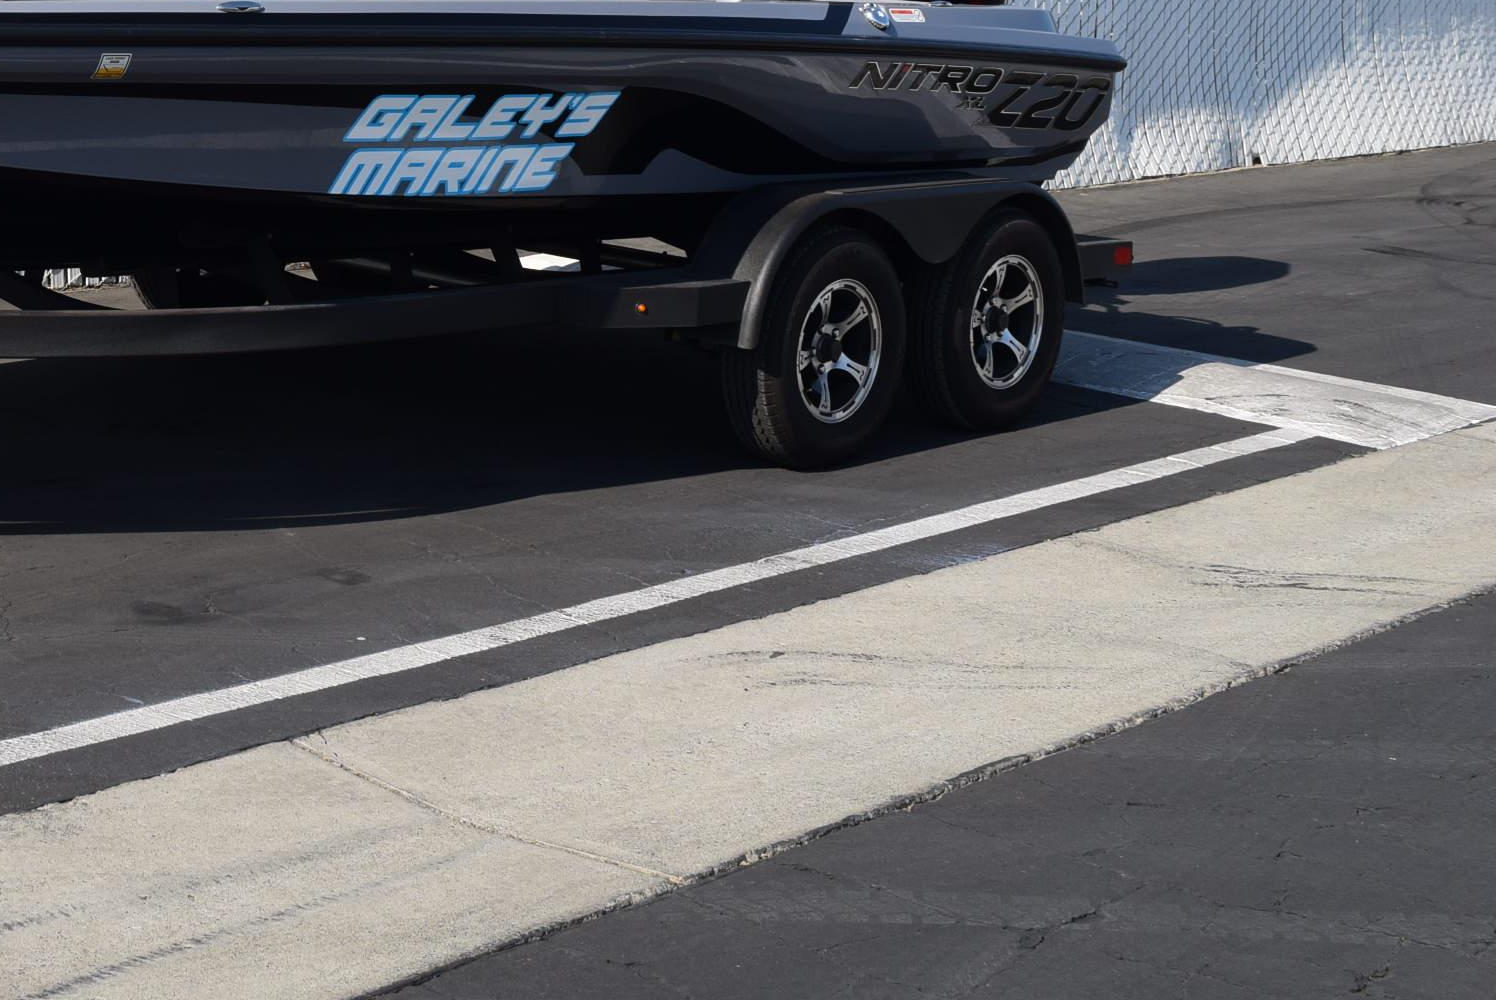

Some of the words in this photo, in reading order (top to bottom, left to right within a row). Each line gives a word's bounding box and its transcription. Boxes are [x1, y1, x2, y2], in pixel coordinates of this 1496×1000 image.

[849, 61, 1004, 94] NITRO
[987, 70, 1113, 131] Z20
[343, 91, 622, 142] GALEY'S
[328, 142, 576, 195] MARINE
